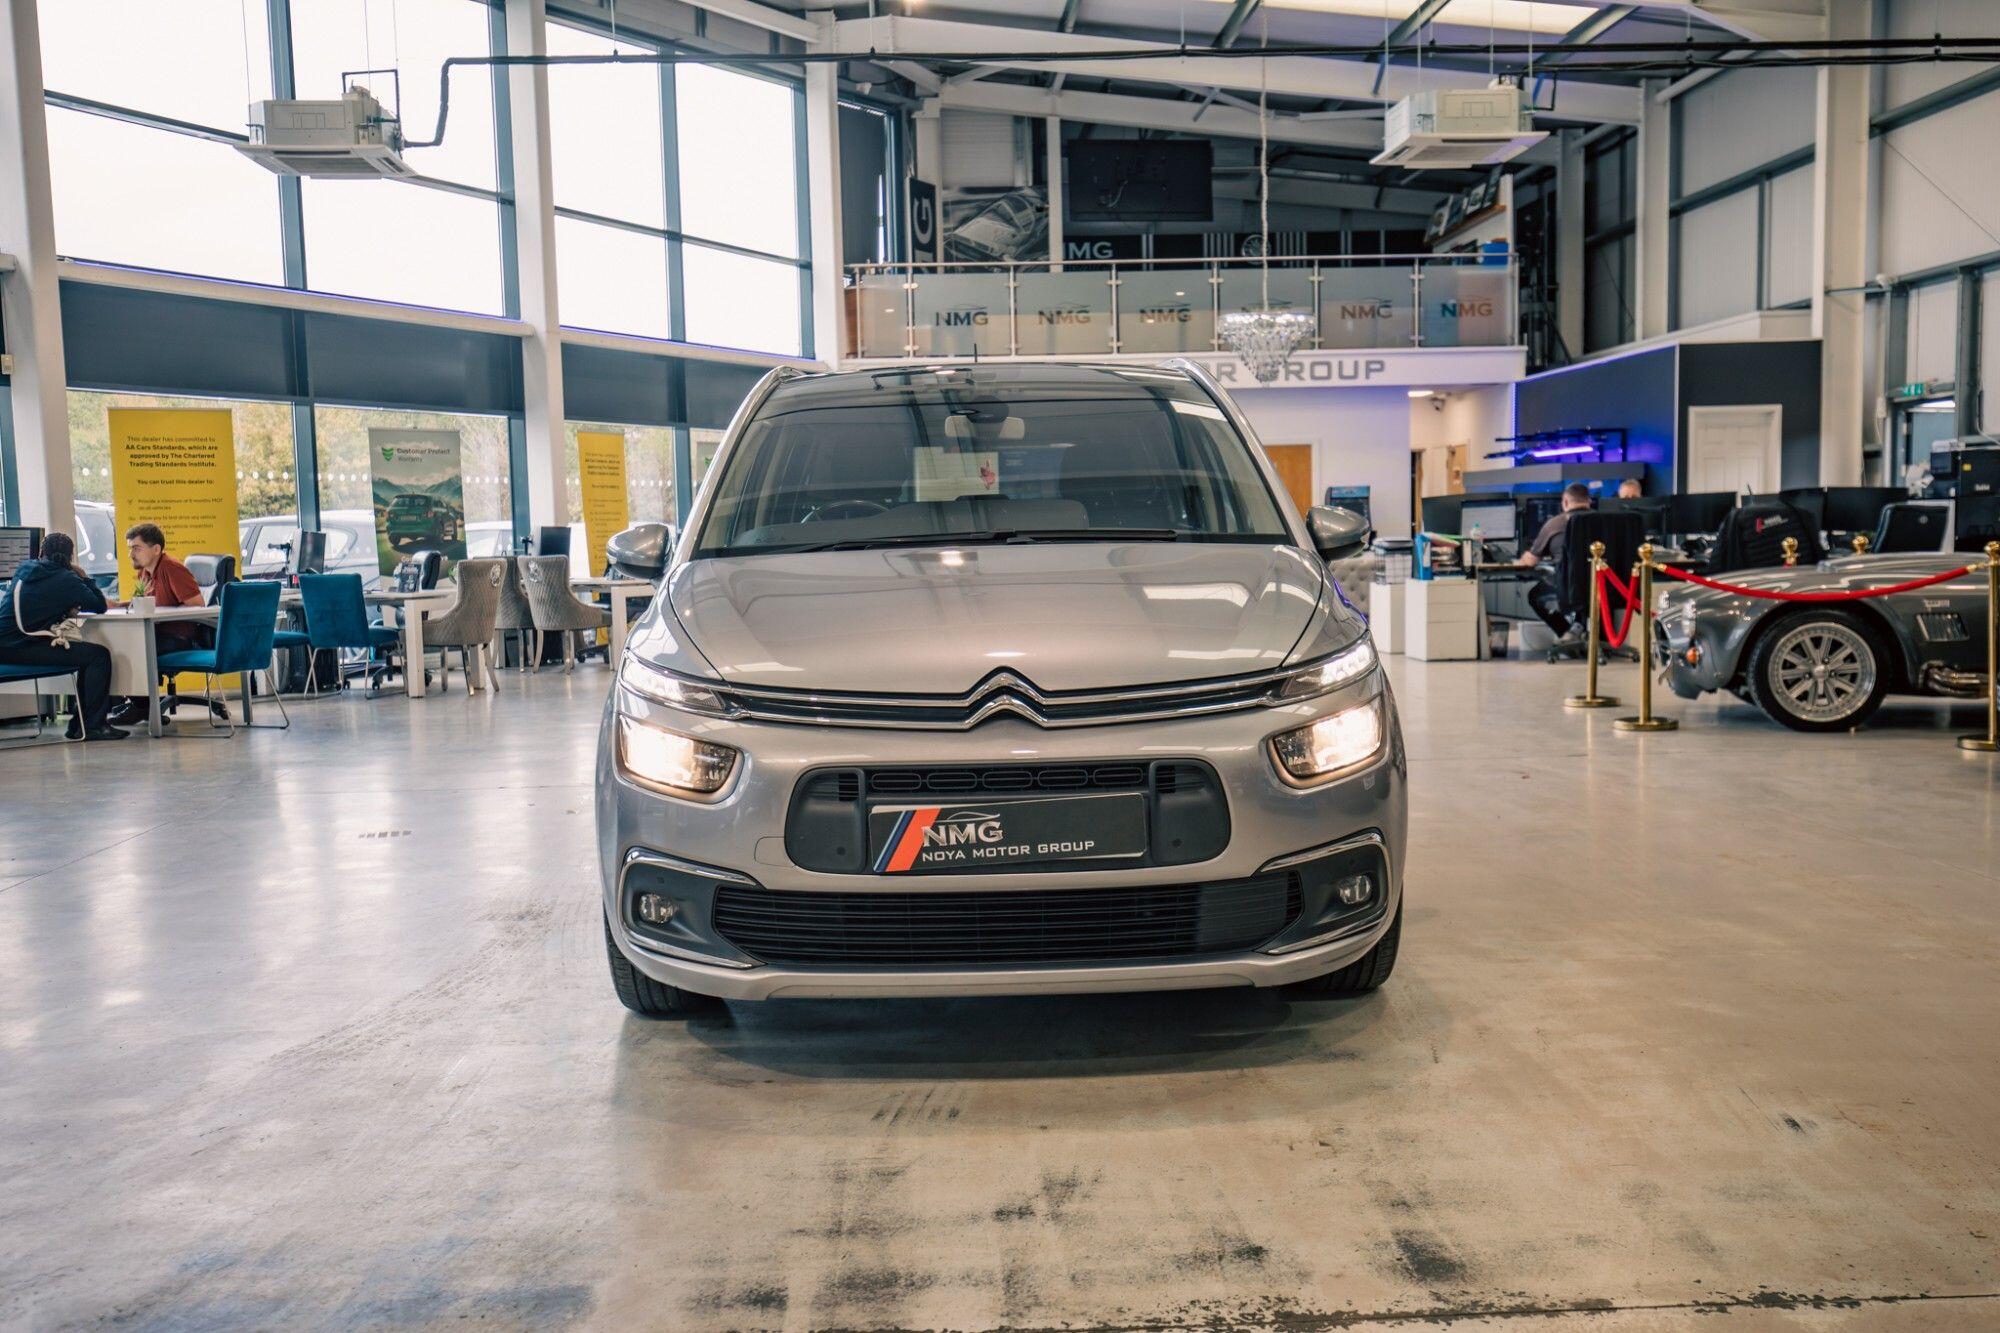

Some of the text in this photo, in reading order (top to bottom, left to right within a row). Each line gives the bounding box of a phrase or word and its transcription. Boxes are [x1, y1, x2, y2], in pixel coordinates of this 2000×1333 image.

[1063, 241, 1114, 259] MG
[1038, 309, 1091, 325] NMG
[1139, 308, 1193, 323] NMG
[1442, 303, 1493, 318] NMG
[936, 311, 989, 327] NMG
[396, 447, 426, 455] Customer
[921, 821, 1003, 847] NMG
[922, 840, 1095, 862] NOYA MOTOR GROUP
